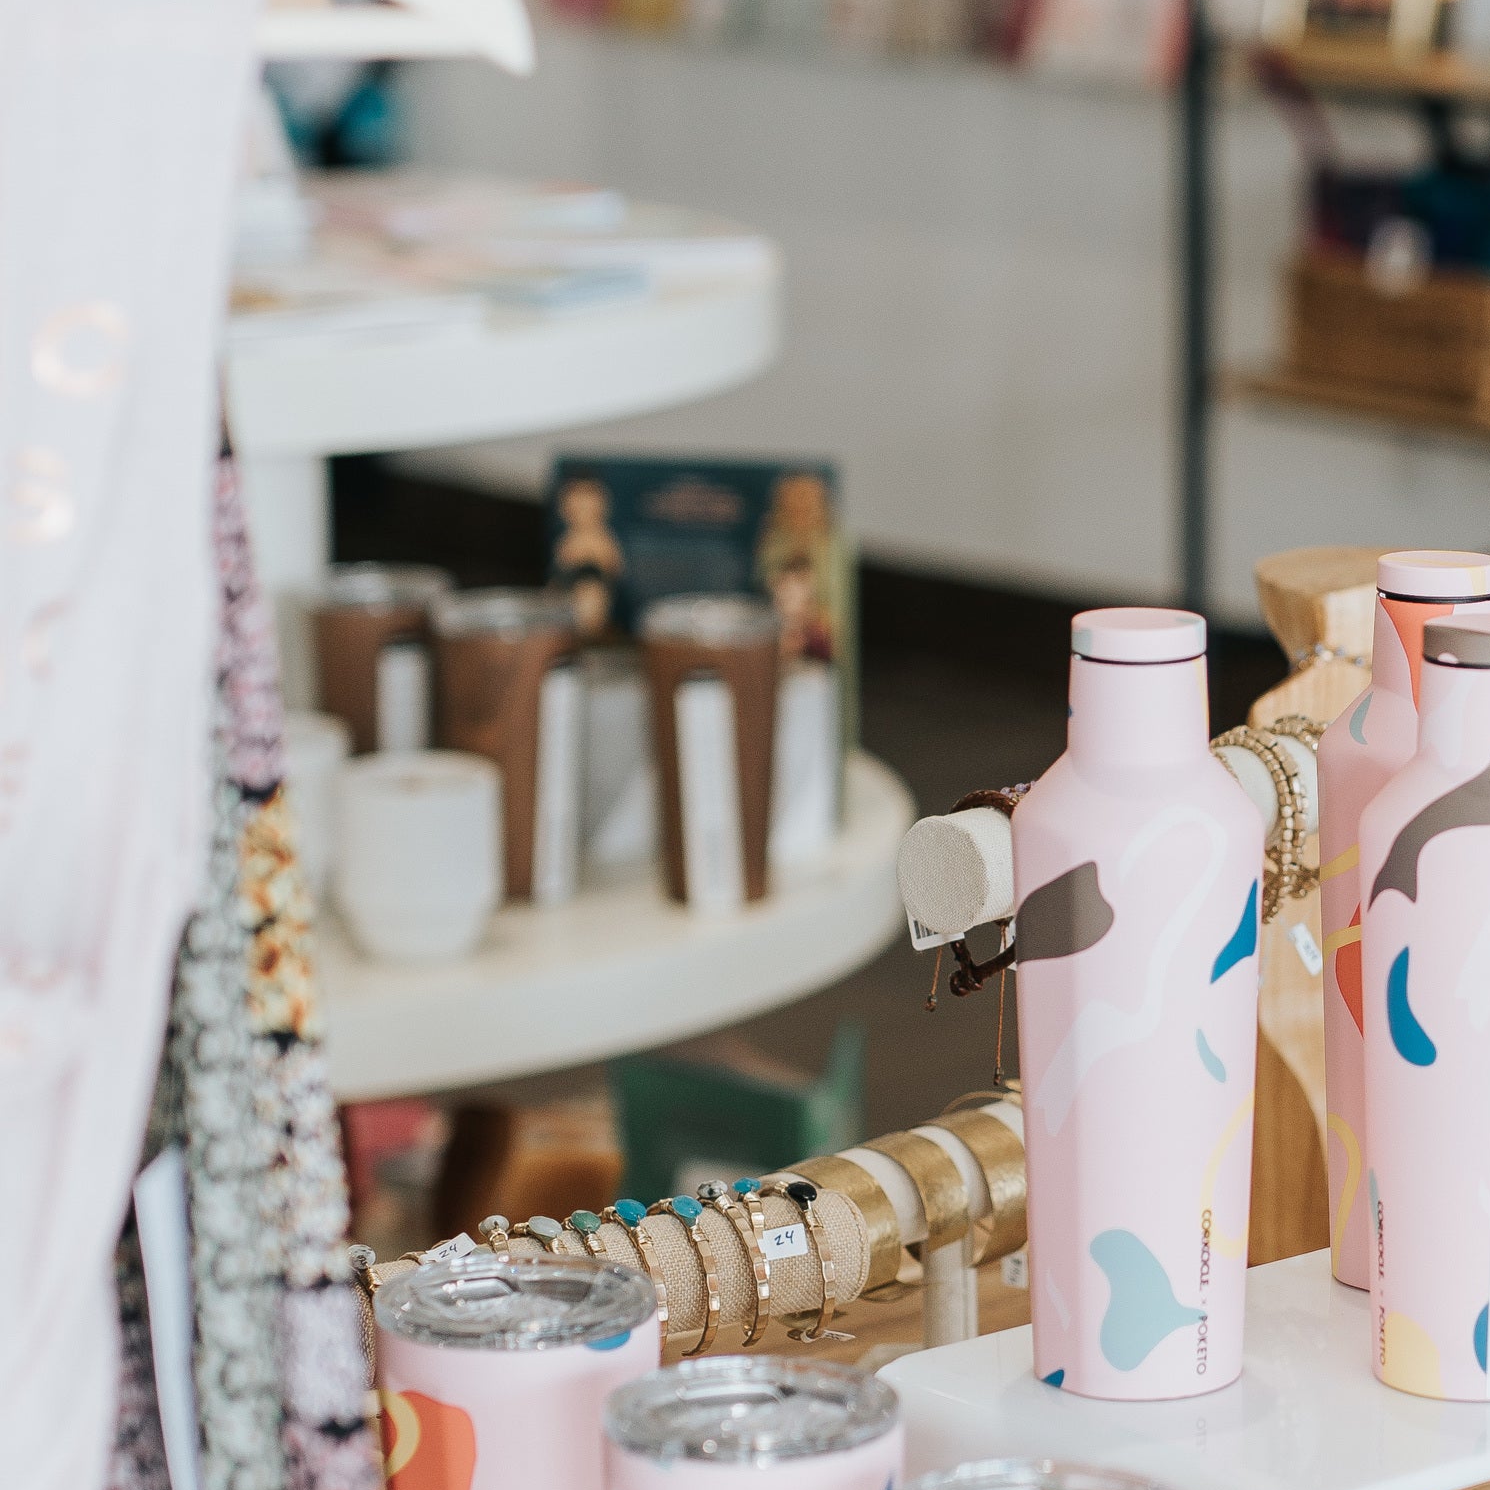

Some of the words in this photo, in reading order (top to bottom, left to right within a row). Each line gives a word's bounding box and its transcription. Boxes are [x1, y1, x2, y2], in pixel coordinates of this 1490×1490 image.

[775, 1230, 795, 1246] 24
[439, 1244, 457, 1259] 24
[1196, 1314, 1208, 1375] POKETO
